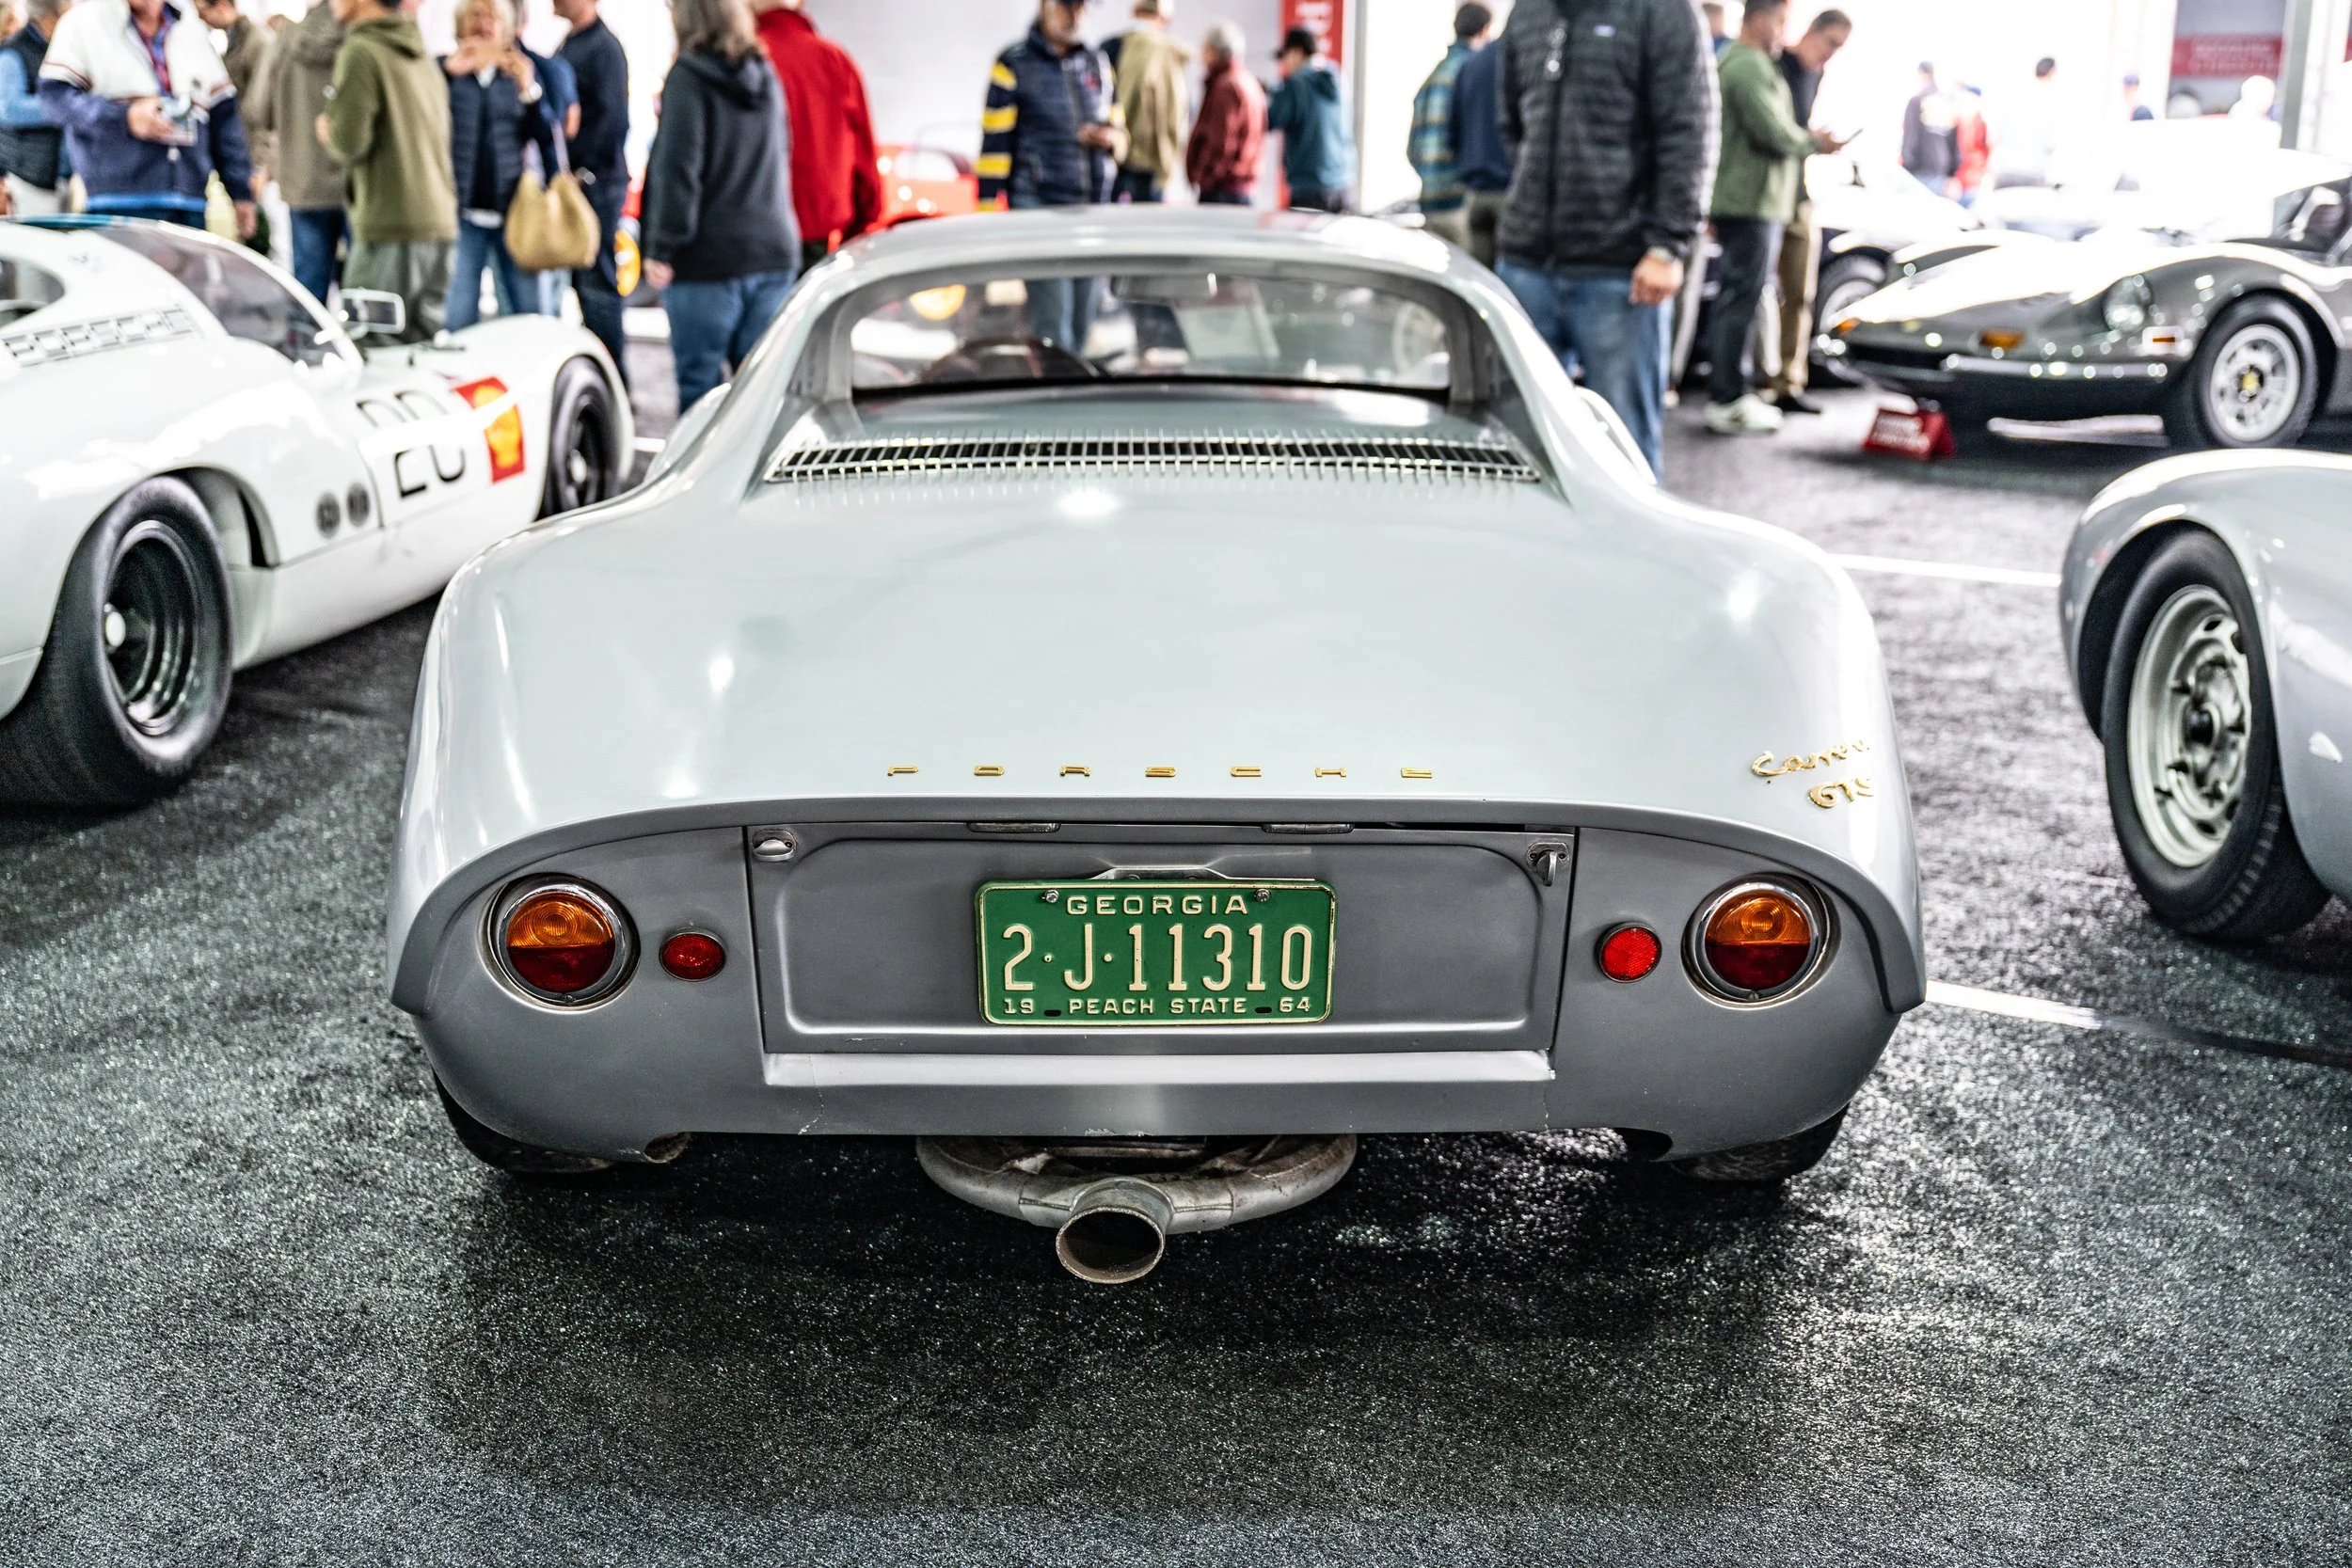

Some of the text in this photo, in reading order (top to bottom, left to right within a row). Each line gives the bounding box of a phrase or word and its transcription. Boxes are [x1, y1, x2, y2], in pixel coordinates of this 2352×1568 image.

[887, 765, 1433, 780] PORSCHE
[1066, 895, 1248, 915] GEORGIA
[1003, 996, 1311, 1015] 19 PEACH STATE 64
